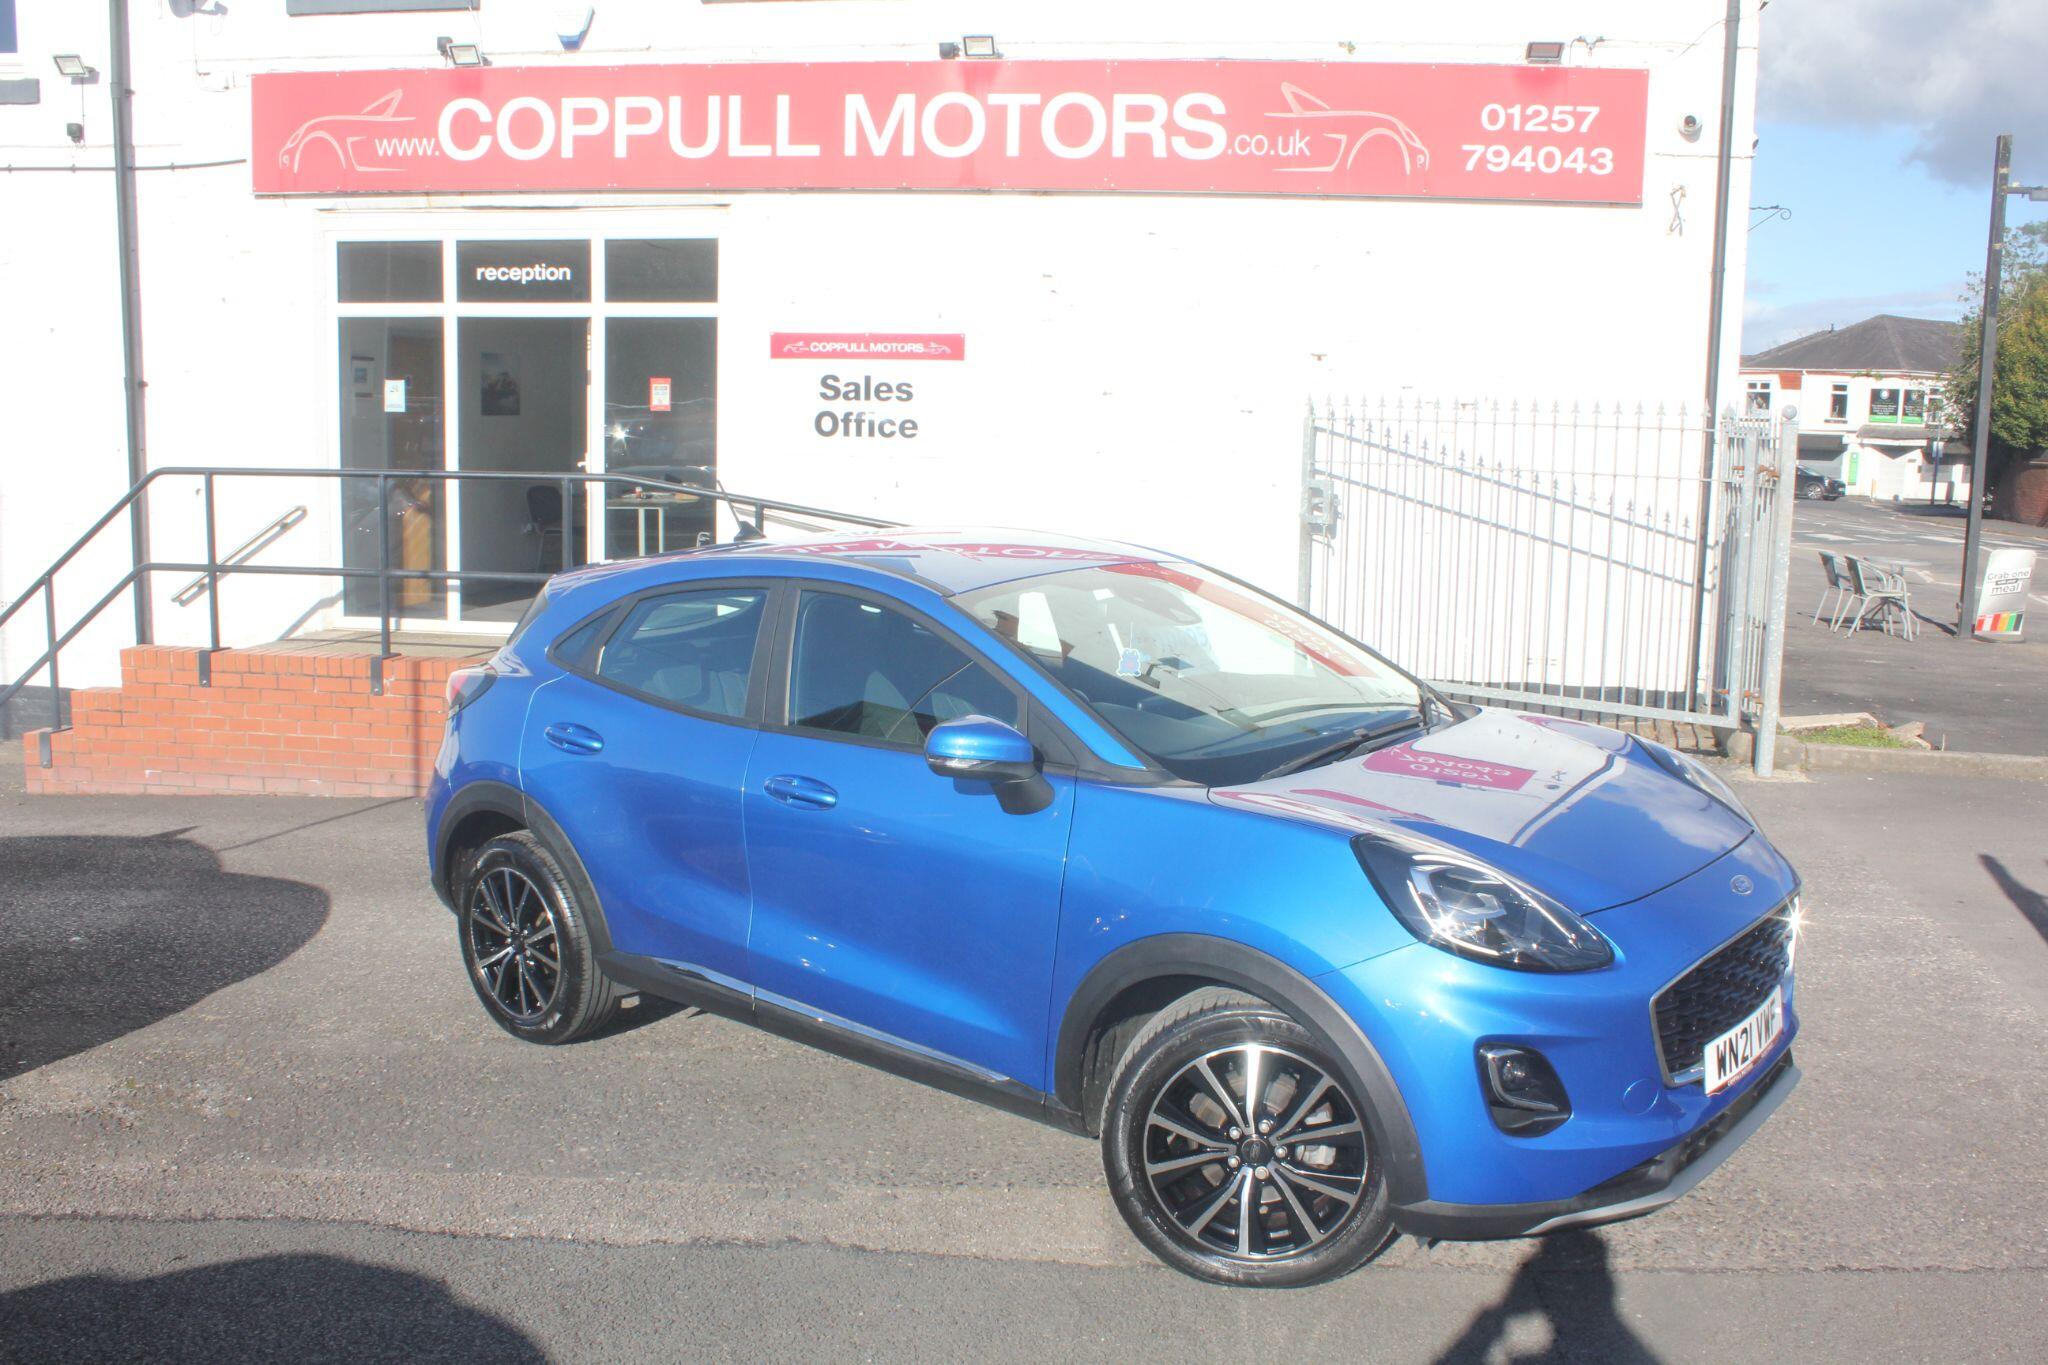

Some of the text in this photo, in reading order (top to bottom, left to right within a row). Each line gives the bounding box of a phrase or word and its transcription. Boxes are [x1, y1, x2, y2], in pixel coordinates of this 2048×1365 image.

[1481, 103, 1600, 133] 01257
[1461, 144, 1614, 175] 794043
[476, 263, 571, 285] reception
[810, 342, 925, 354] COPPULL MOTORS
[819, 374, 914, 402] Sales
[814, 410, 918, 439] Office
[1716, 1023, 1753, 1080] WN21
